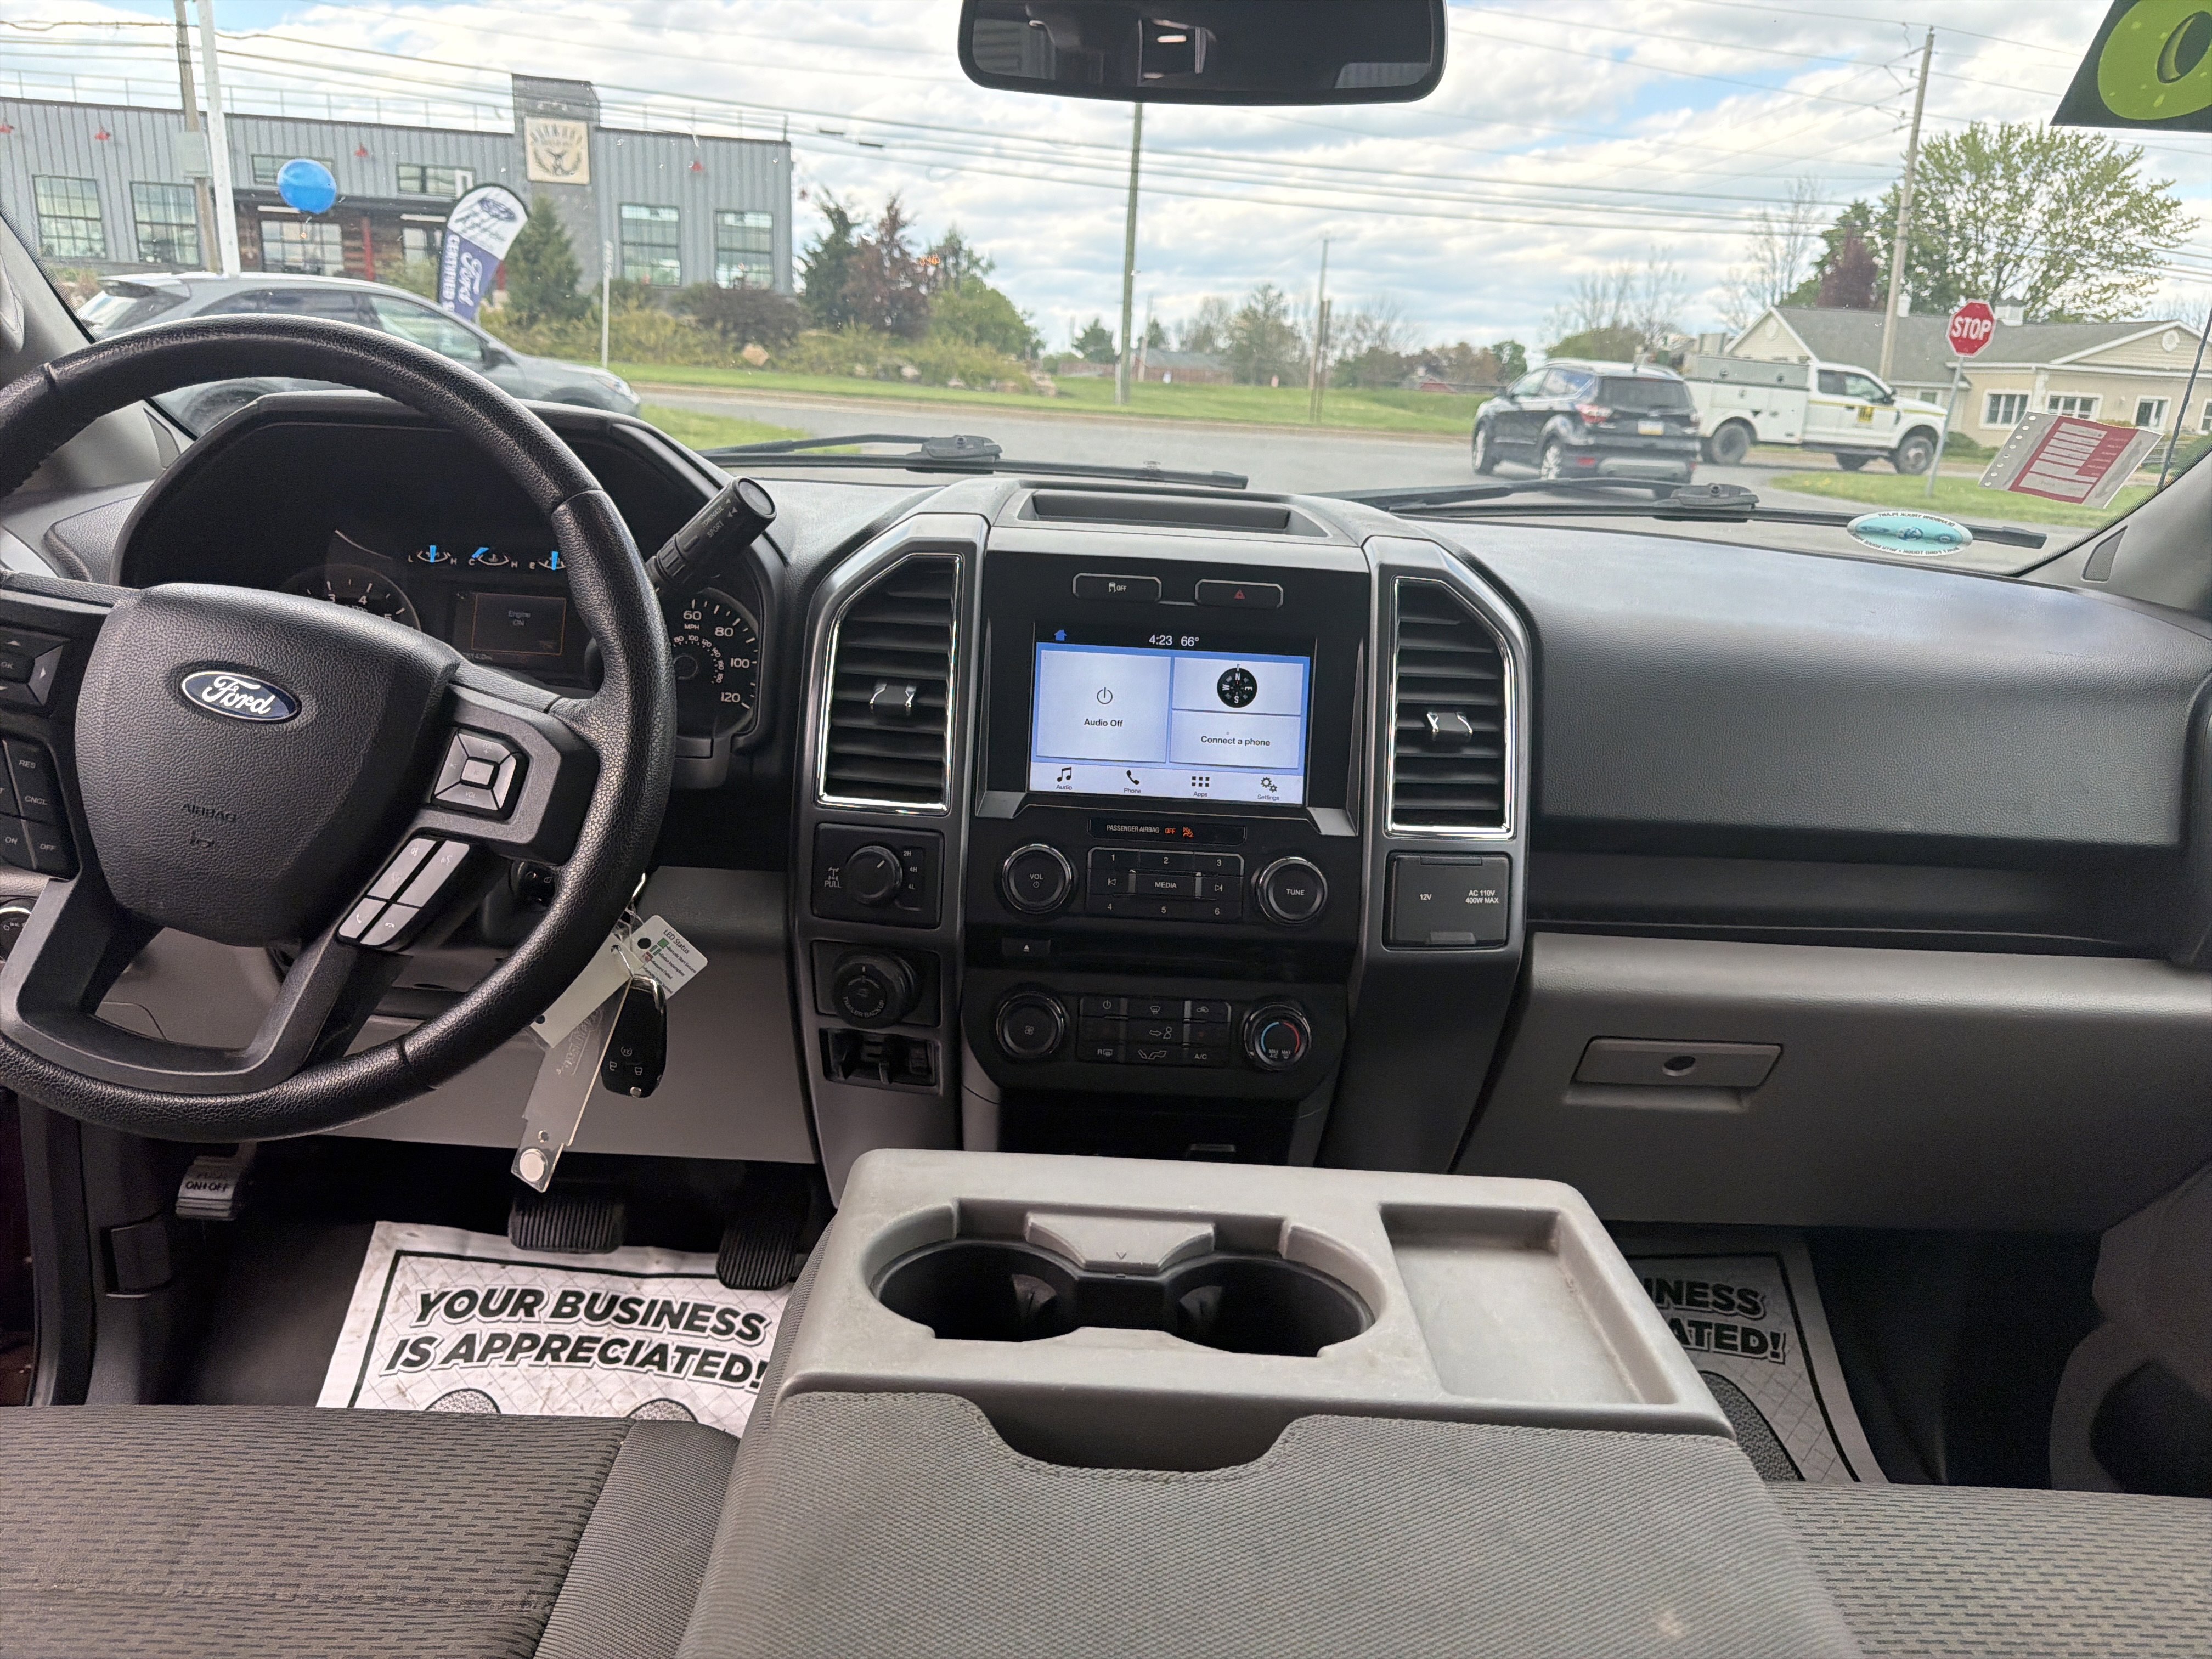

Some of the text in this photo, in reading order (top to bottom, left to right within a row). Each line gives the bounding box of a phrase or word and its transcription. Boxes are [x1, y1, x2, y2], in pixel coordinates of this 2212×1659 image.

[458, 252, 483, 307] Ford
[1951, 315, 1992, 341] STOP
[707, 520, 724, 538] SPORT
[408, 555, 414, 563] L
[328, 594, 336, 603] 3
[358, 595, 368, 605] 4
[683, 610, 702, 620] 60
[715, 627, 734, 637] 80
[701, 638, 712, 647] 120
[1149, 634, 1199, 646] 4:23 66°
[730, 658, 750, 668] 100
[202, 675, 276, 714] Ford
[721, 692, 740, 703] 120
[1234, 695, 1239, 703] S
[1084, 718, 1123, 727] Audio Off
[1200, 735, 1236, 745] Connect
[1244, 737, 1271, 747] phone
[19, 760, 36, 769] RES
[25, 795, 48, 805] CNCL
[5, 837, 18, 845] ON
[40, 843, 56, 851] OFF
[825, 880, 842, 888] PULL
[663, 929, 690, 954] LED Status
[843, 996, 864, 1017] TRAILER
[414, 1286, 769, 1344] YOUR BUSINESS
[384, 1331, 768, 1390] IS APPRECIATED!
